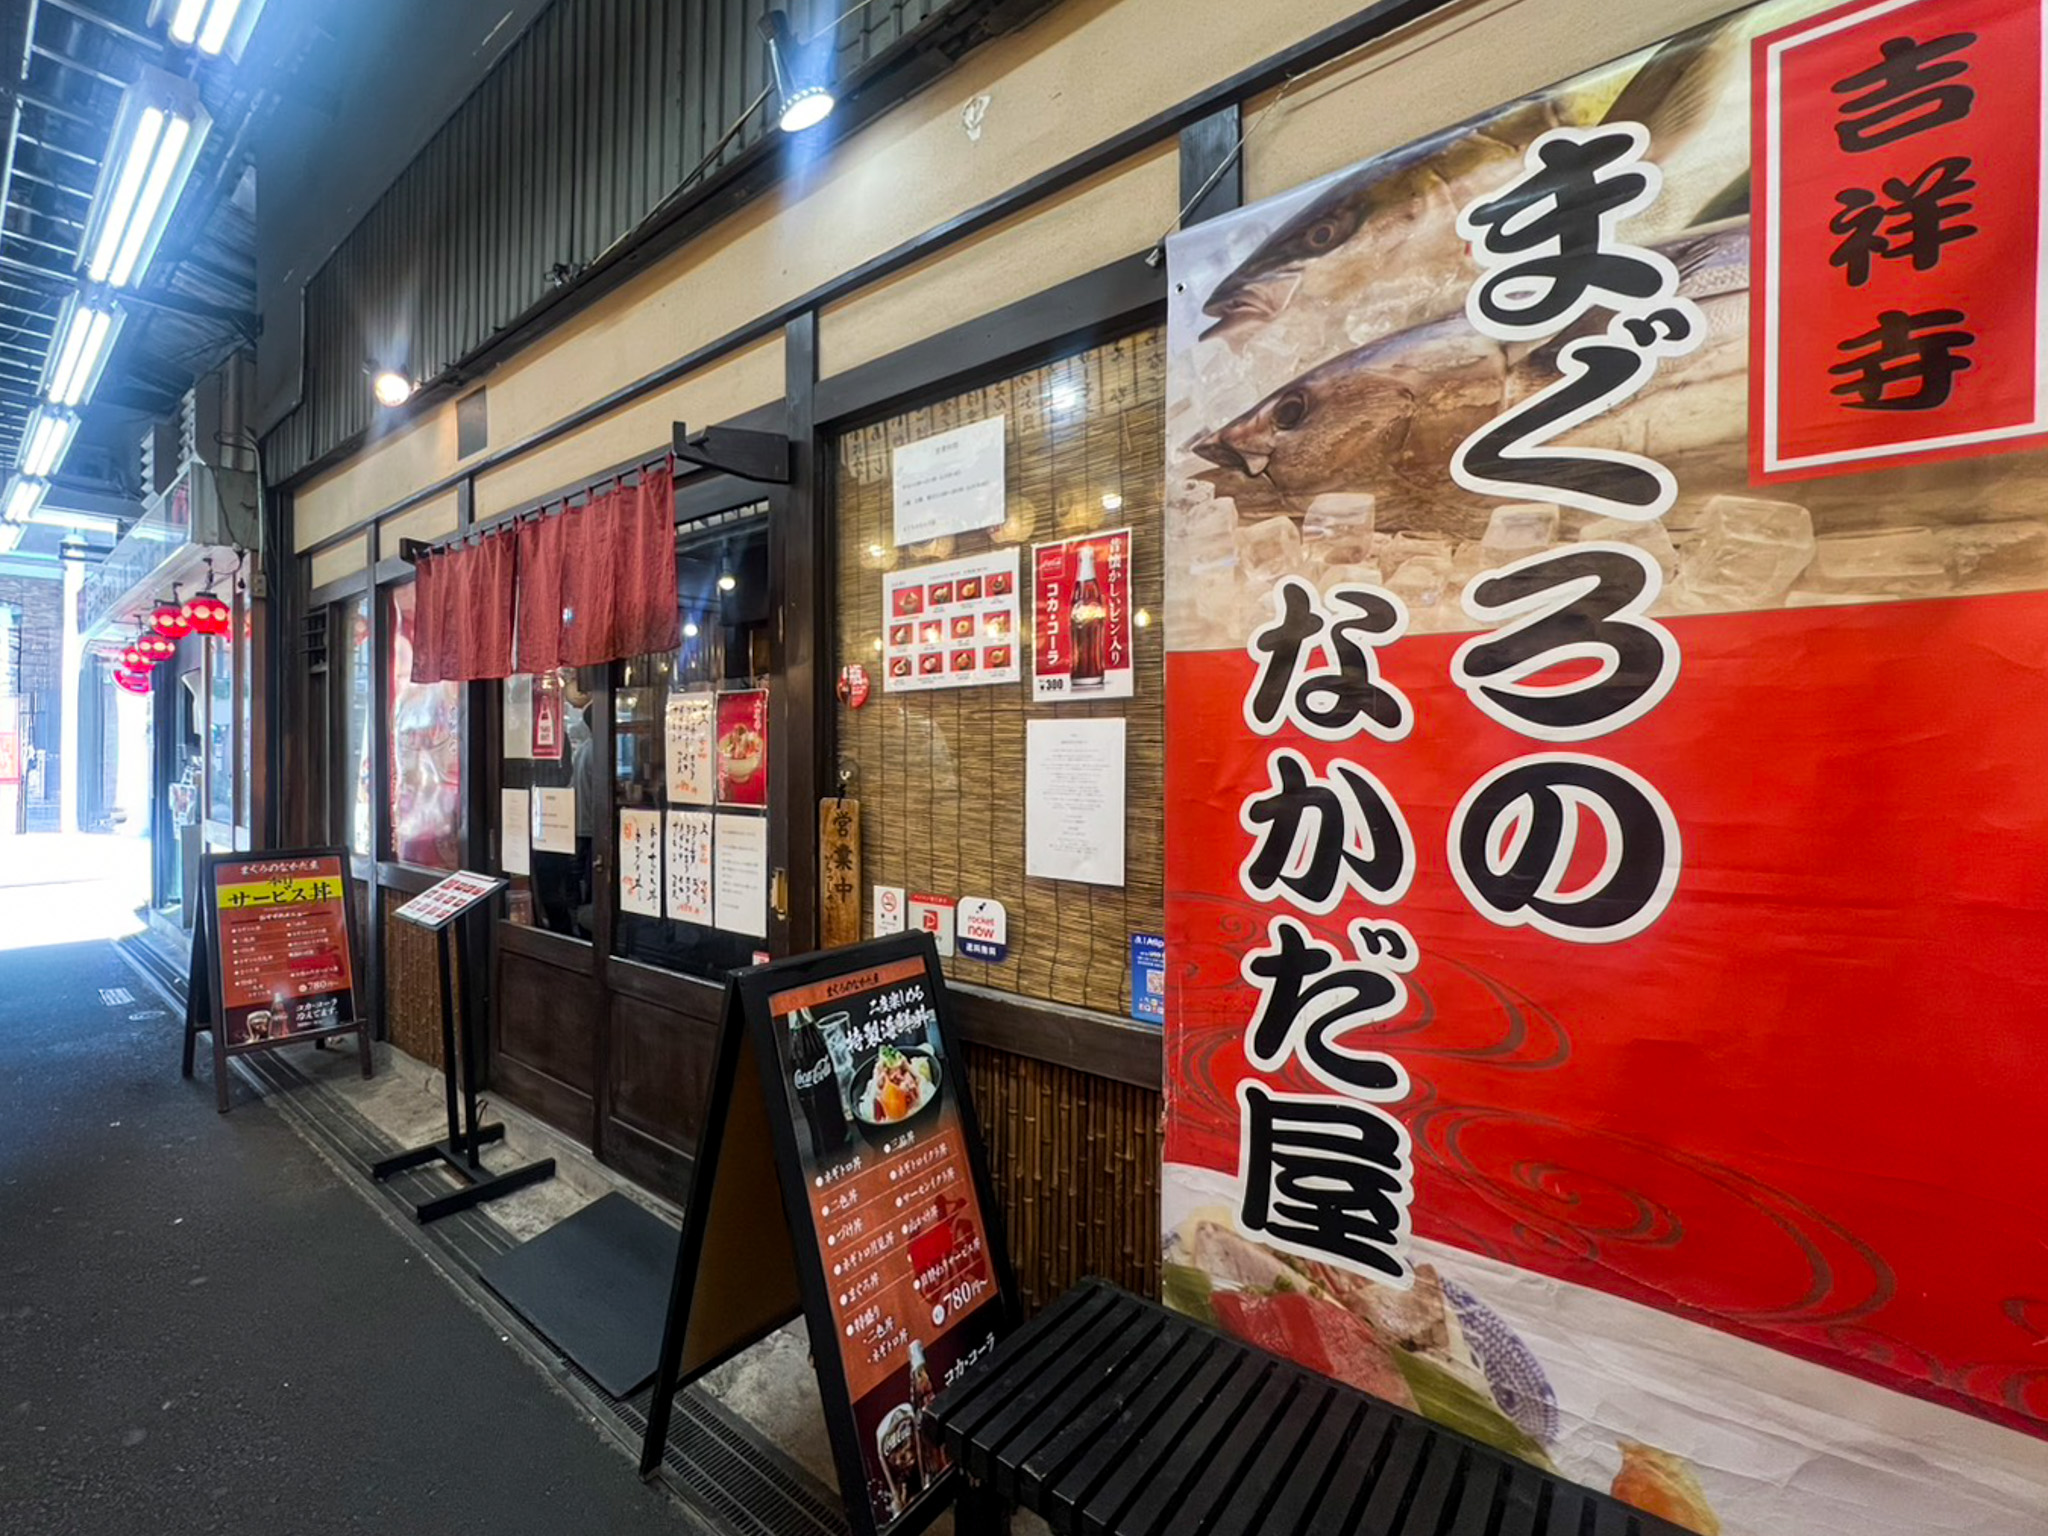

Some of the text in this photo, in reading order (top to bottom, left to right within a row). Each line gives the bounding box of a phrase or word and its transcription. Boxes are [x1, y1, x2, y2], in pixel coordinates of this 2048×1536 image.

[1827, 31, 1981, 411] 吉祥寺
[1456, 128, 1695, 934] まぐろの
[1046, 583, 1060, 666] コカ・コーラ
[833, 811, 853, 903] 営業中
[228, 881, 333, 909] サービス丼
[967, 914, 995, 926] rocket
[967, 925, 995, 939] now
[1239, 579, 1412, 1281] なかだ屋
[823, 1156, 863, 1184] ネギトロ丼
[944, 1332, 996, 1387] コカ・コーラ
